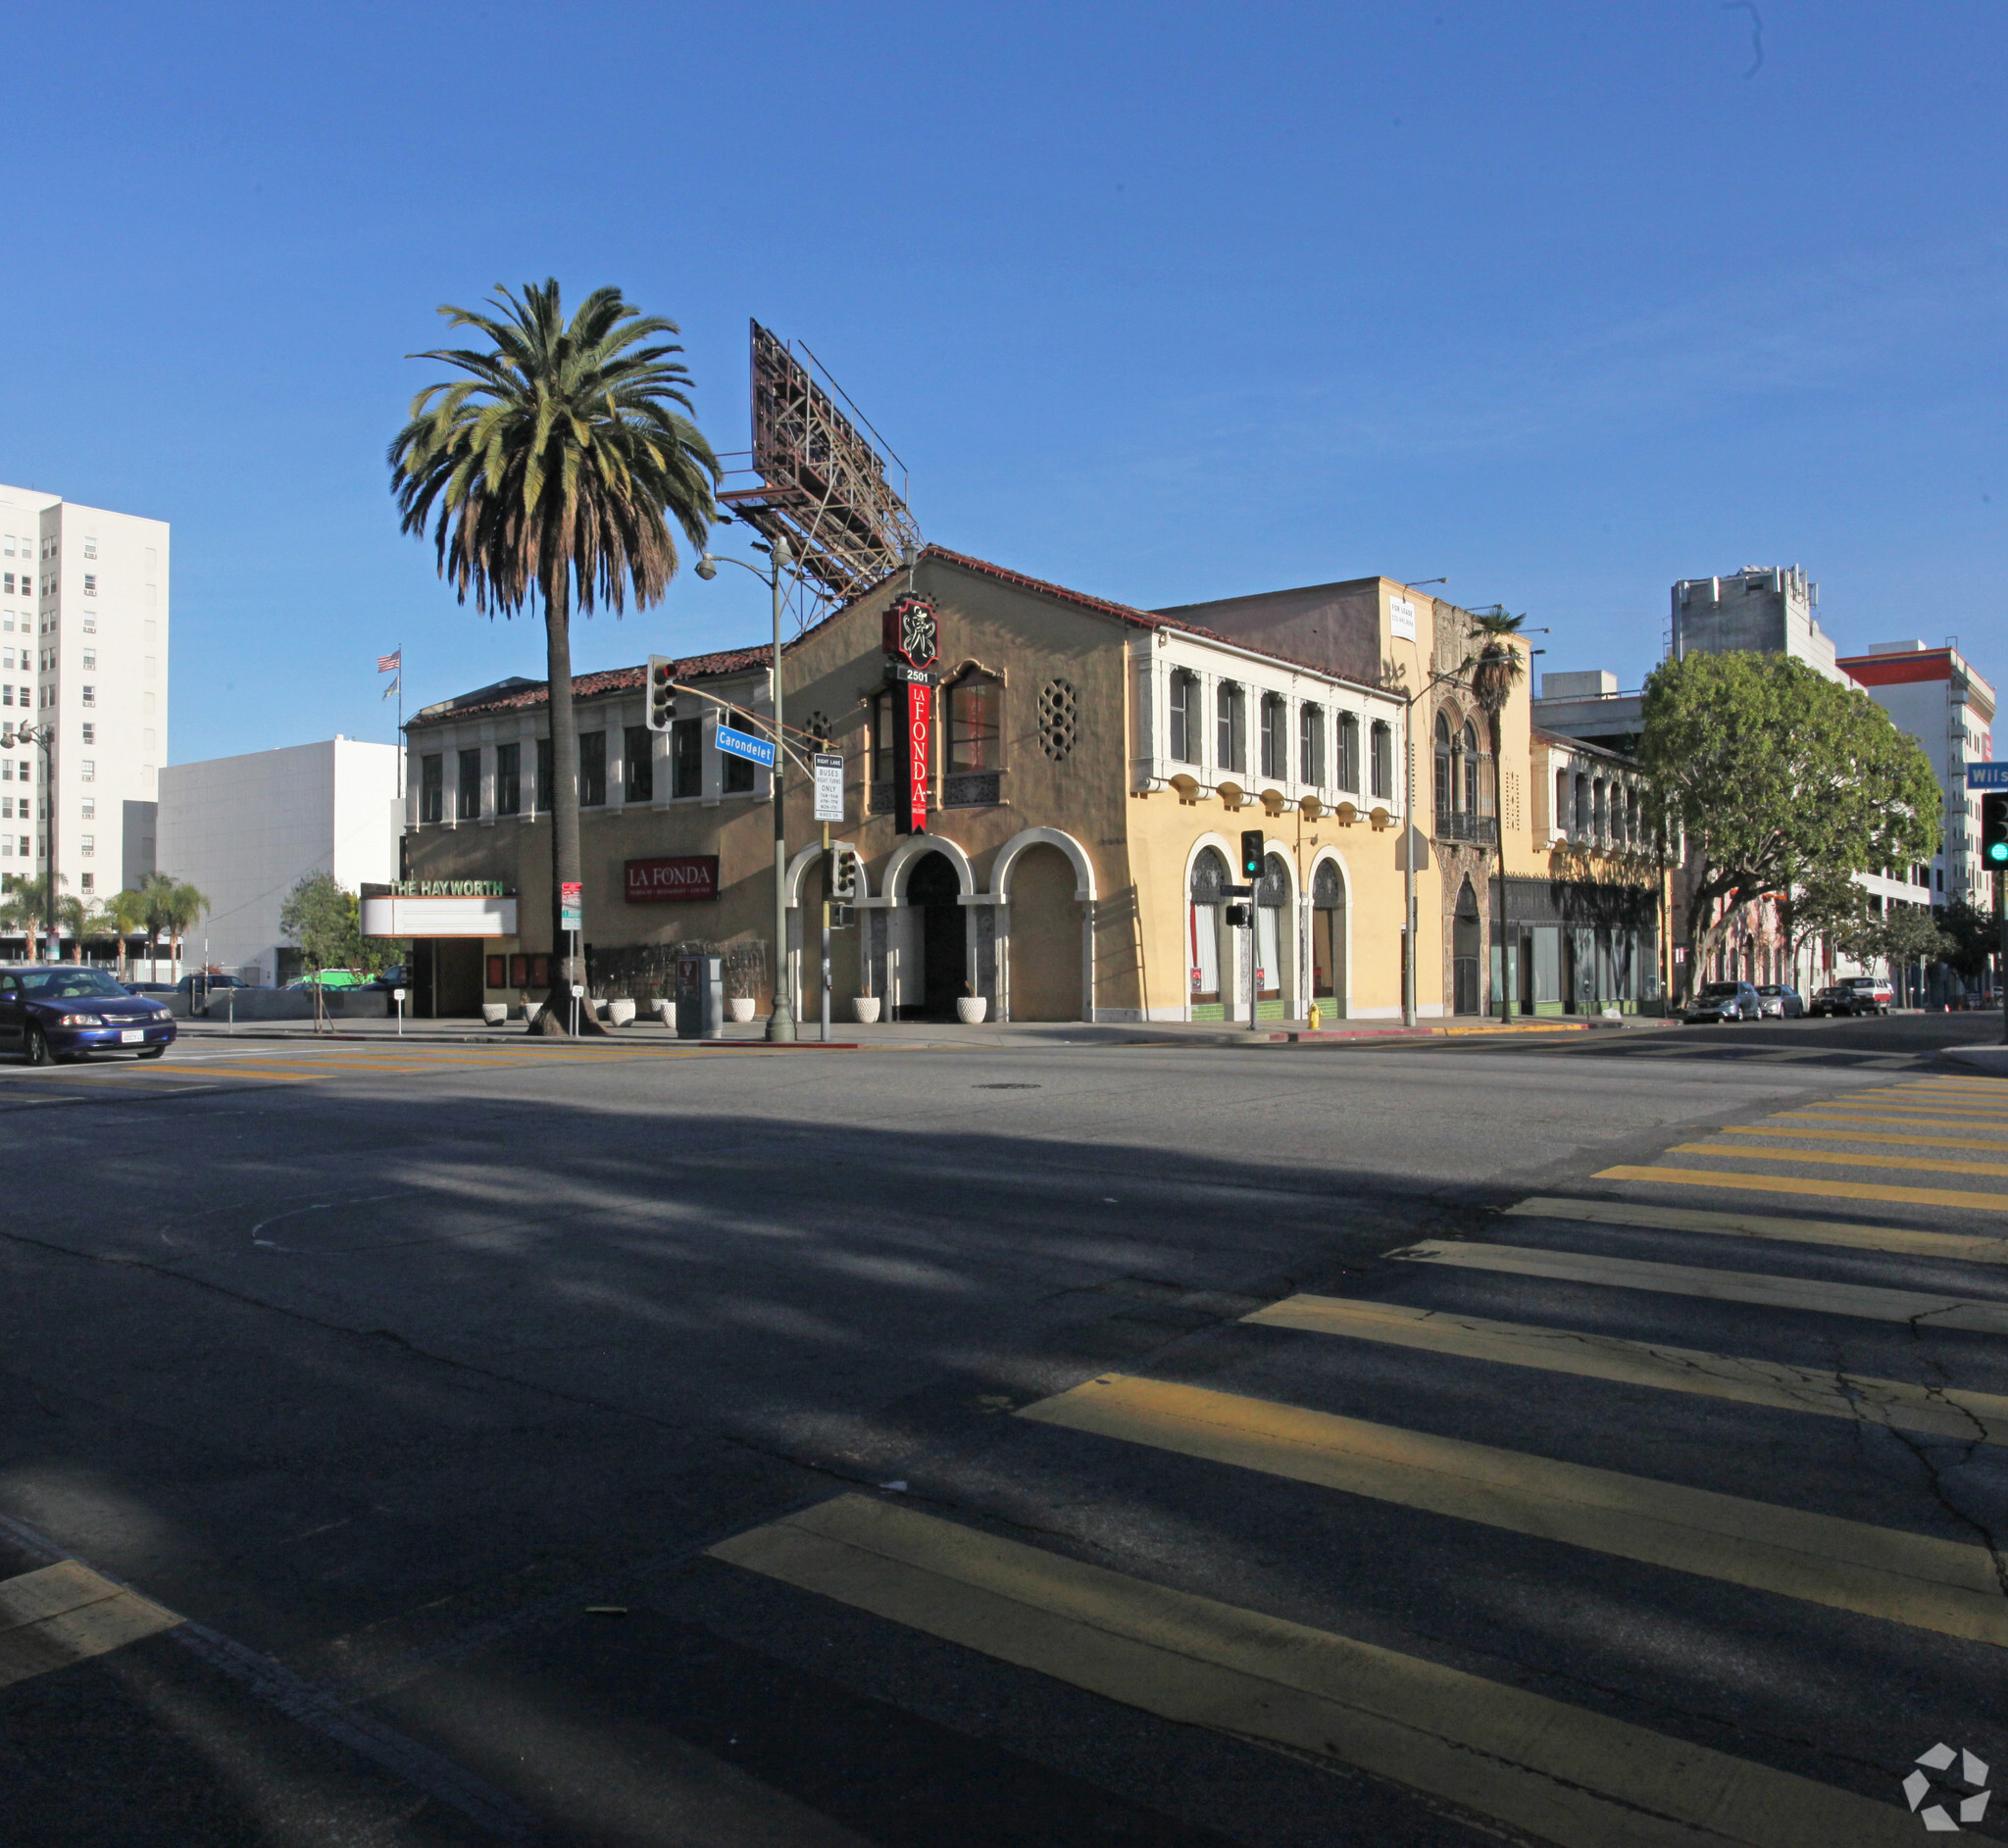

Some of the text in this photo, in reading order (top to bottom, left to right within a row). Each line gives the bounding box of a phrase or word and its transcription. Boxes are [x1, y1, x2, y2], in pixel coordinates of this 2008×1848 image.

[907, 670, 929, 682] 2501
[914, 688, 926, 701] LA
[720, 731, 772, 760] Carondelet
[913, 701, 927, 802] FONDA
[1973, 769, 2008, 782] Wils
[629, 867, 711, 886] LA FONDA
[390, 880, 418, 896] THE
